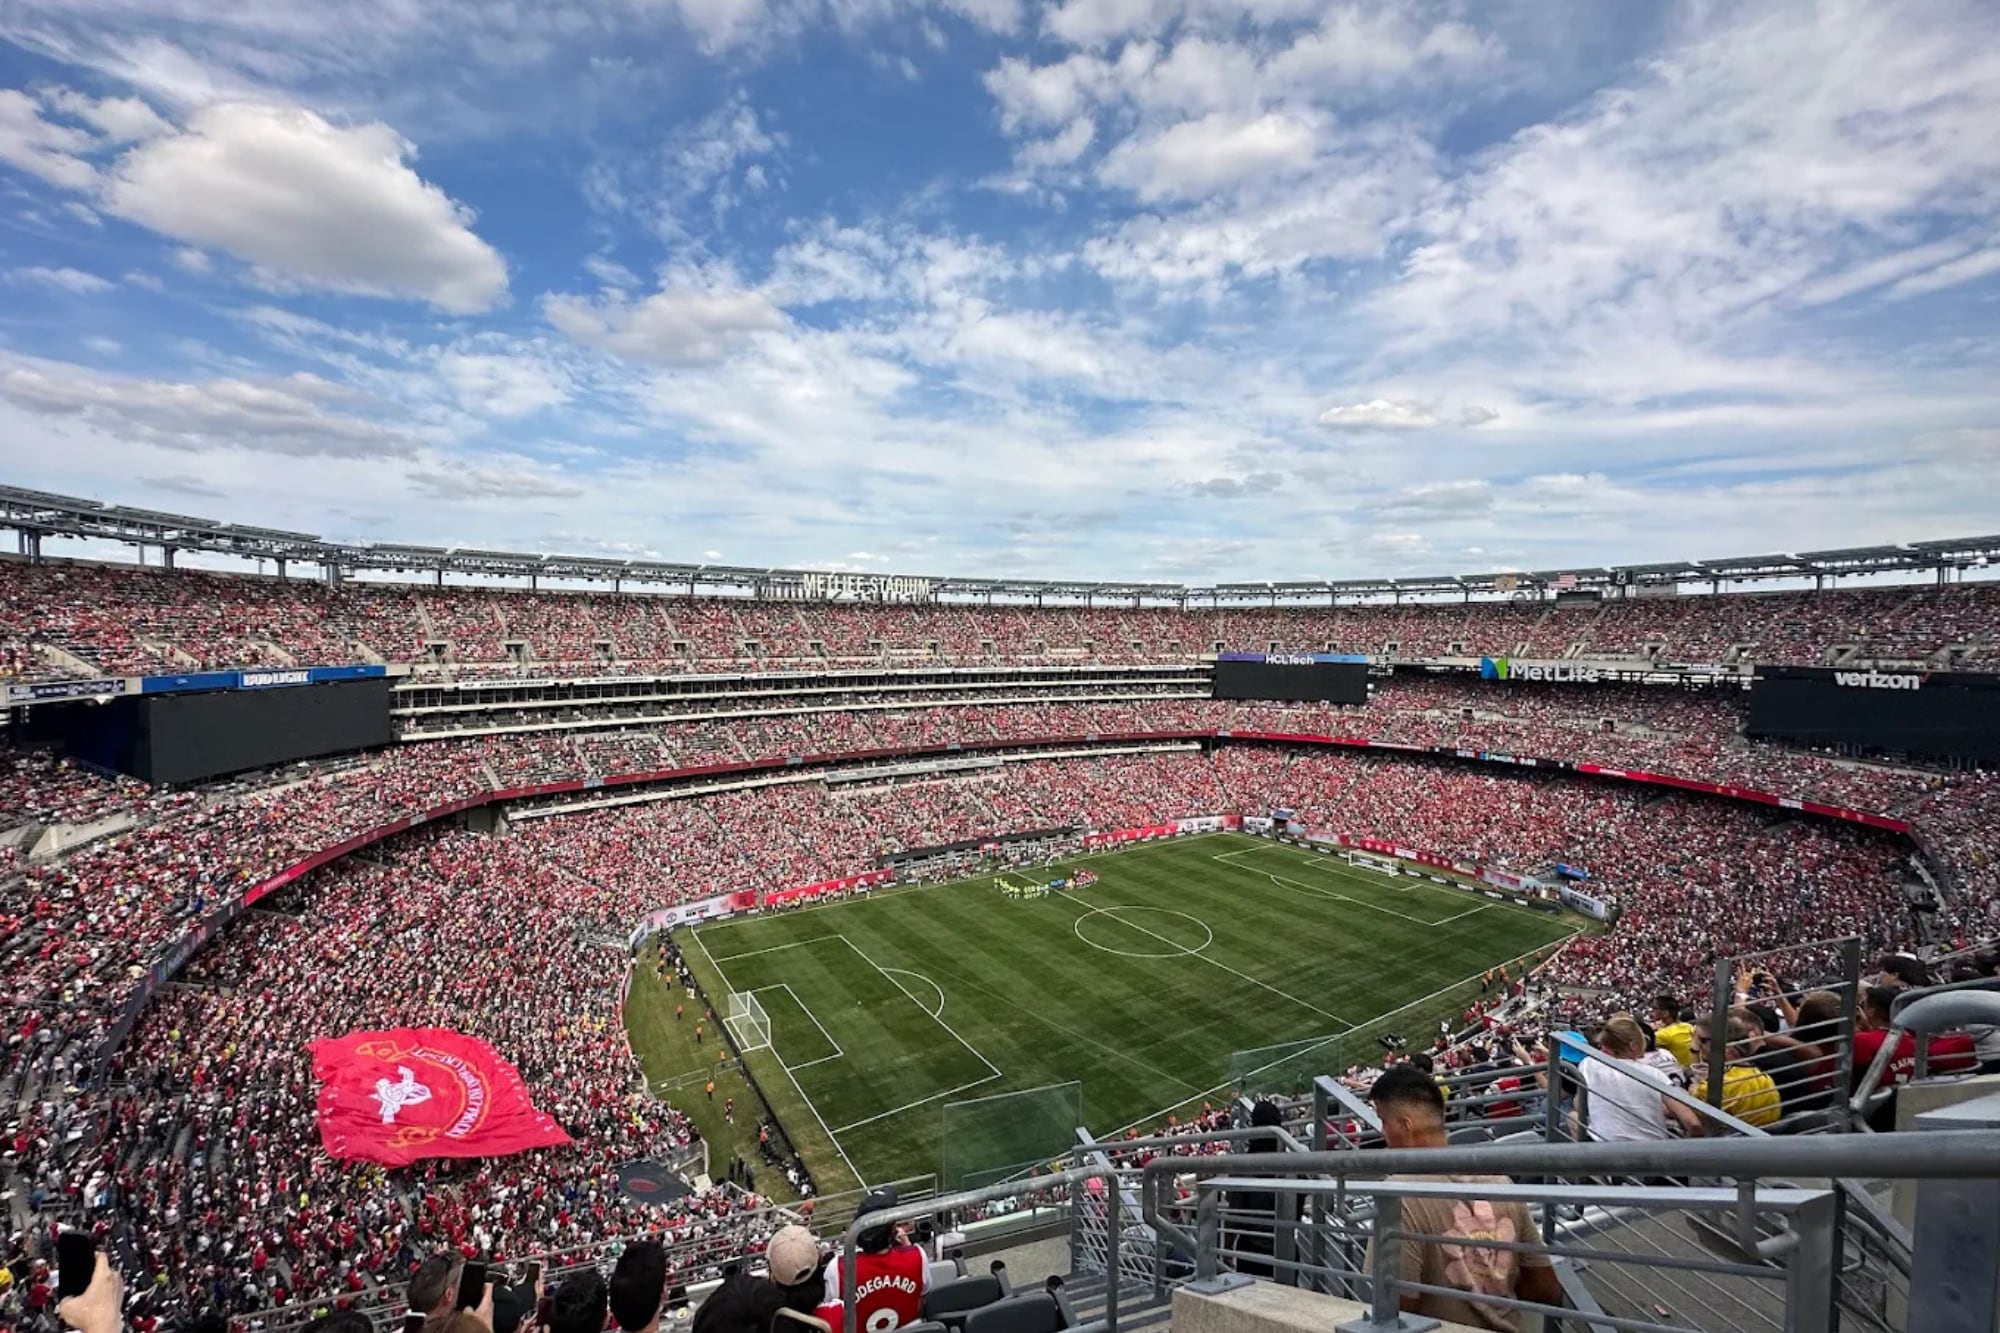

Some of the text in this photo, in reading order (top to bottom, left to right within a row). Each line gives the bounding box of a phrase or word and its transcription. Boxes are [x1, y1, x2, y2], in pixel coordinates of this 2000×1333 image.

[803, 573, 930, 597] METLIFE STADIUM
[1265, 655, 1314, 665] HCLTech
[1510, 662, 1599, 682] MetLife
[1834, 670, 1919, 690] verizon
